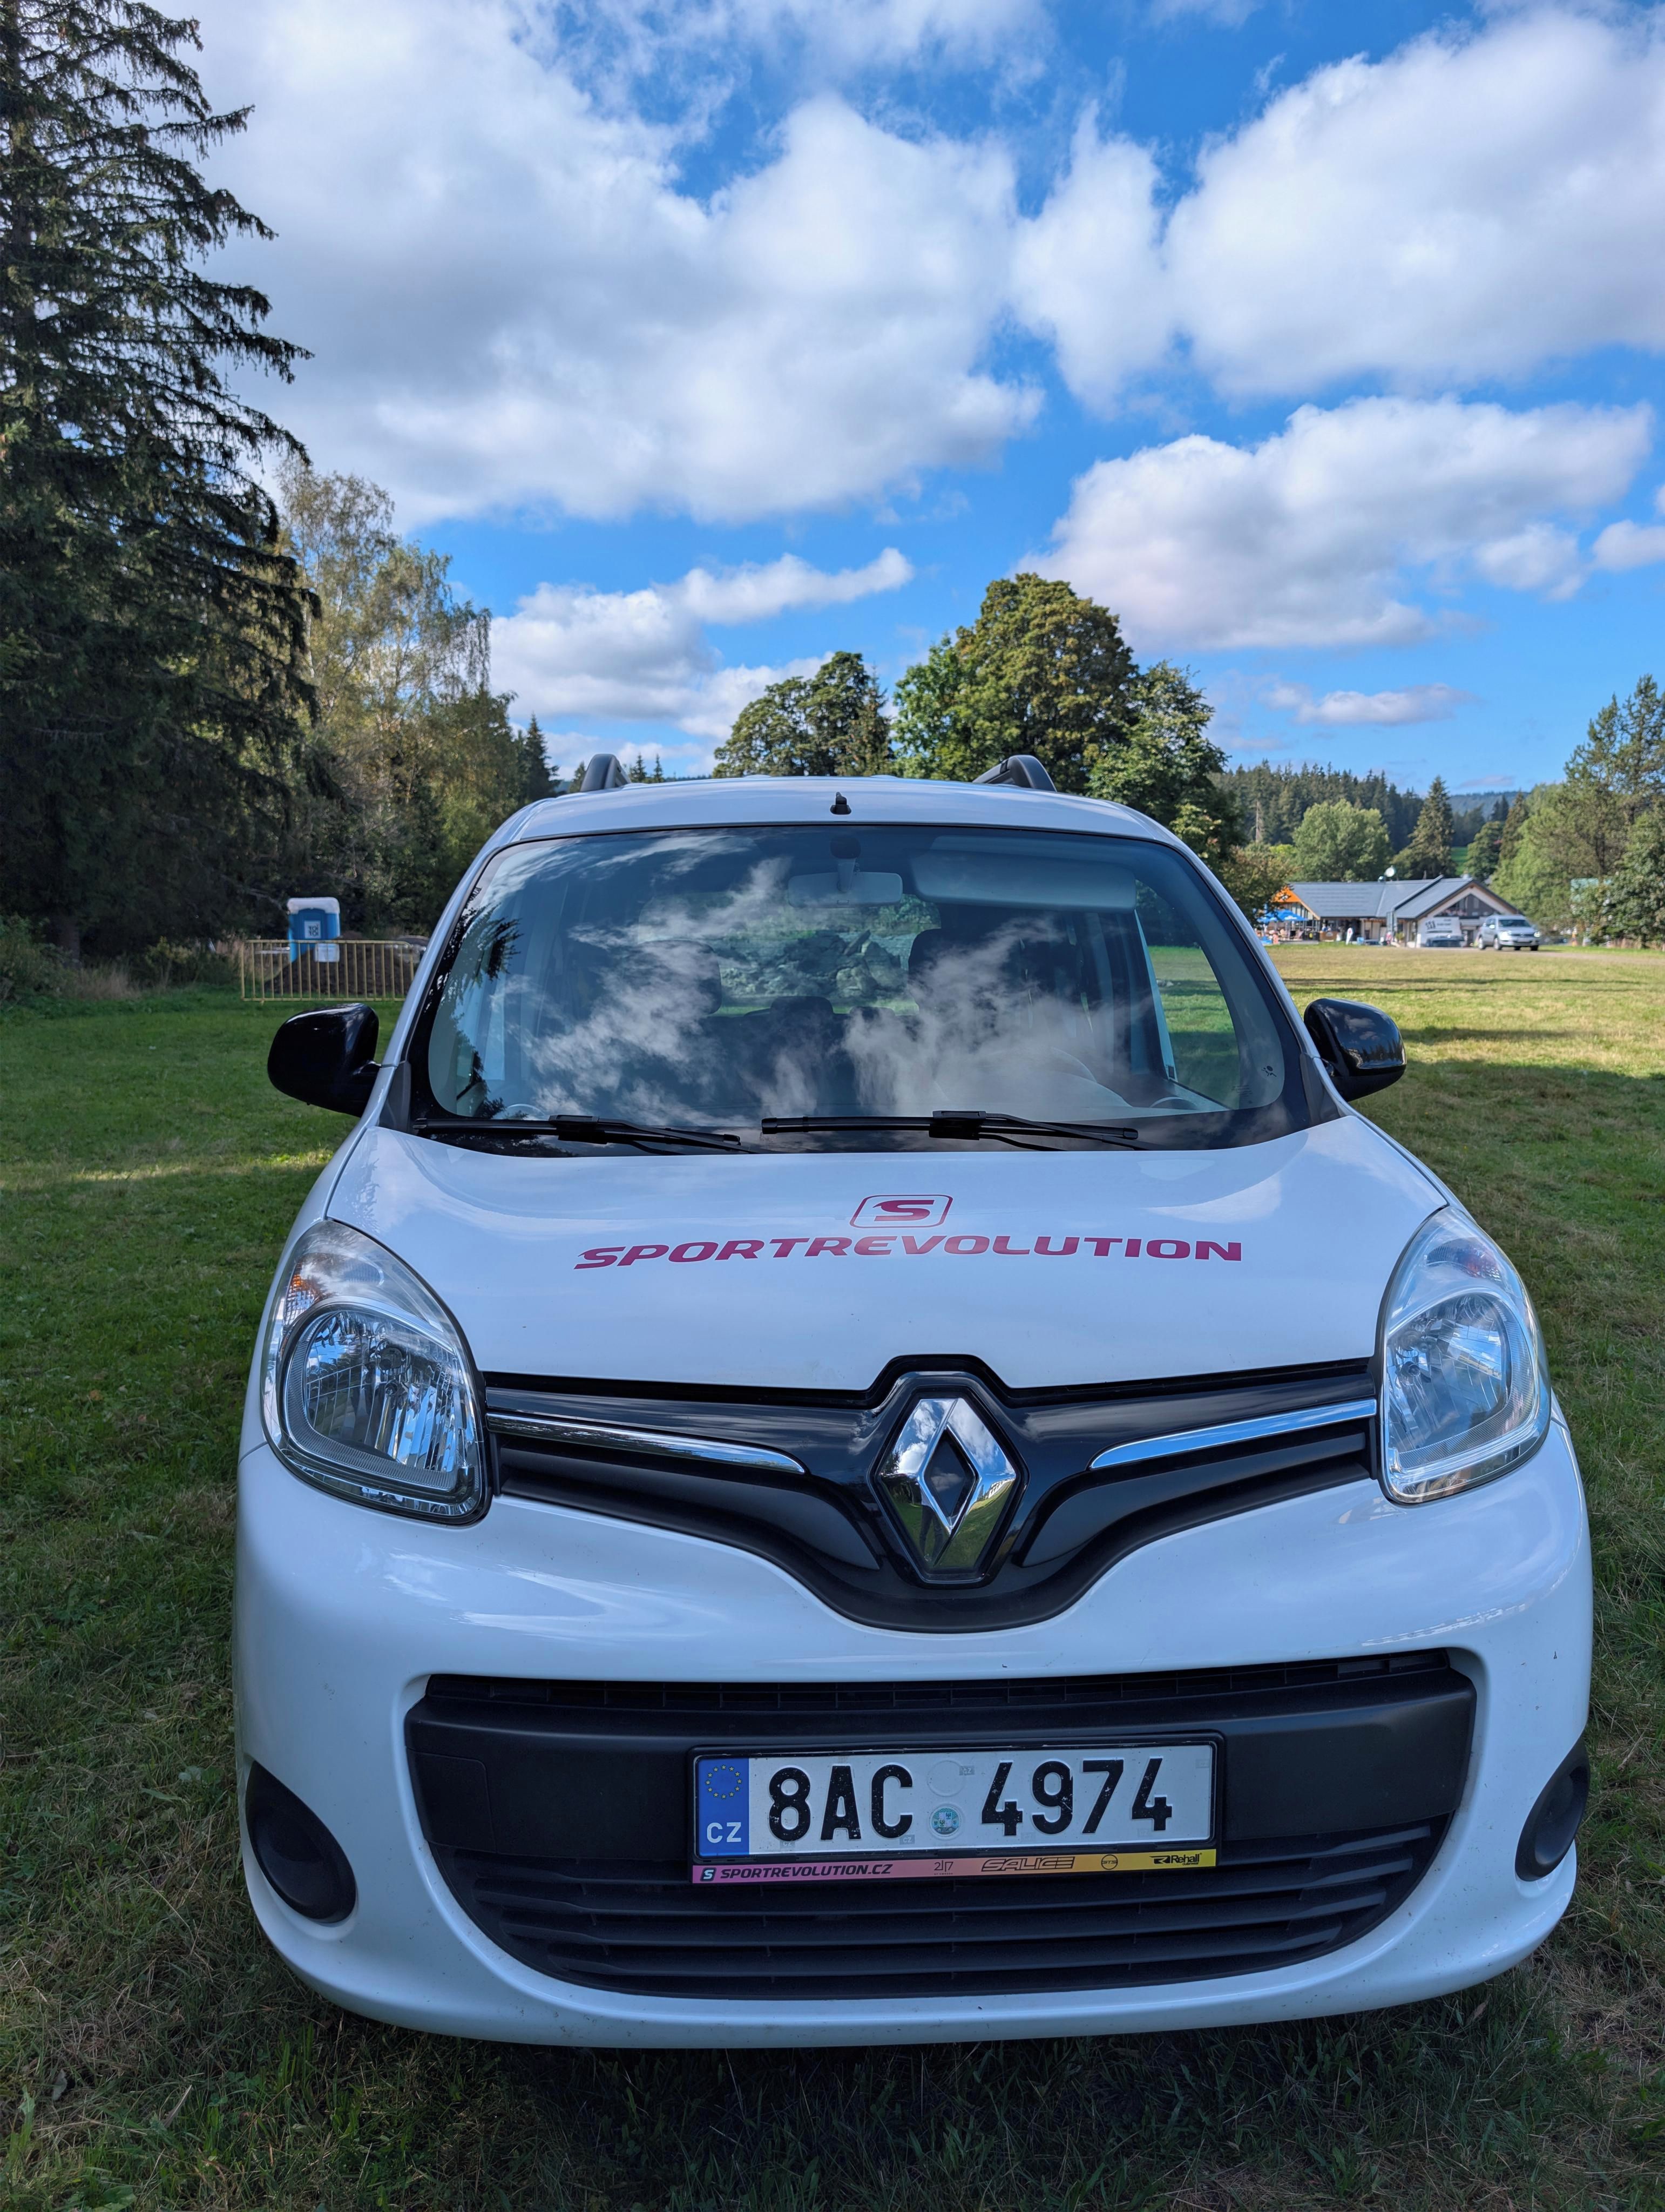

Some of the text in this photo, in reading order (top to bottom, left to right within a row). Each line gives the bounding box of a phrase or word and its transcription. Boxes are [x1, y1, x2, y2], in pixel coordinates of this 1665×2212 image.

[574, 1235, 1242, 1269] SPORTREVOLUTION
[707, 1758, 1173, 1843] CZ 8AC 4974
[982, 1857, 1075, 1872] SALICE
[1171, 1853, 1200, 1864] Rehall
[720, 1864, 893, 1879] SPORTREVOLUTION.CZ
